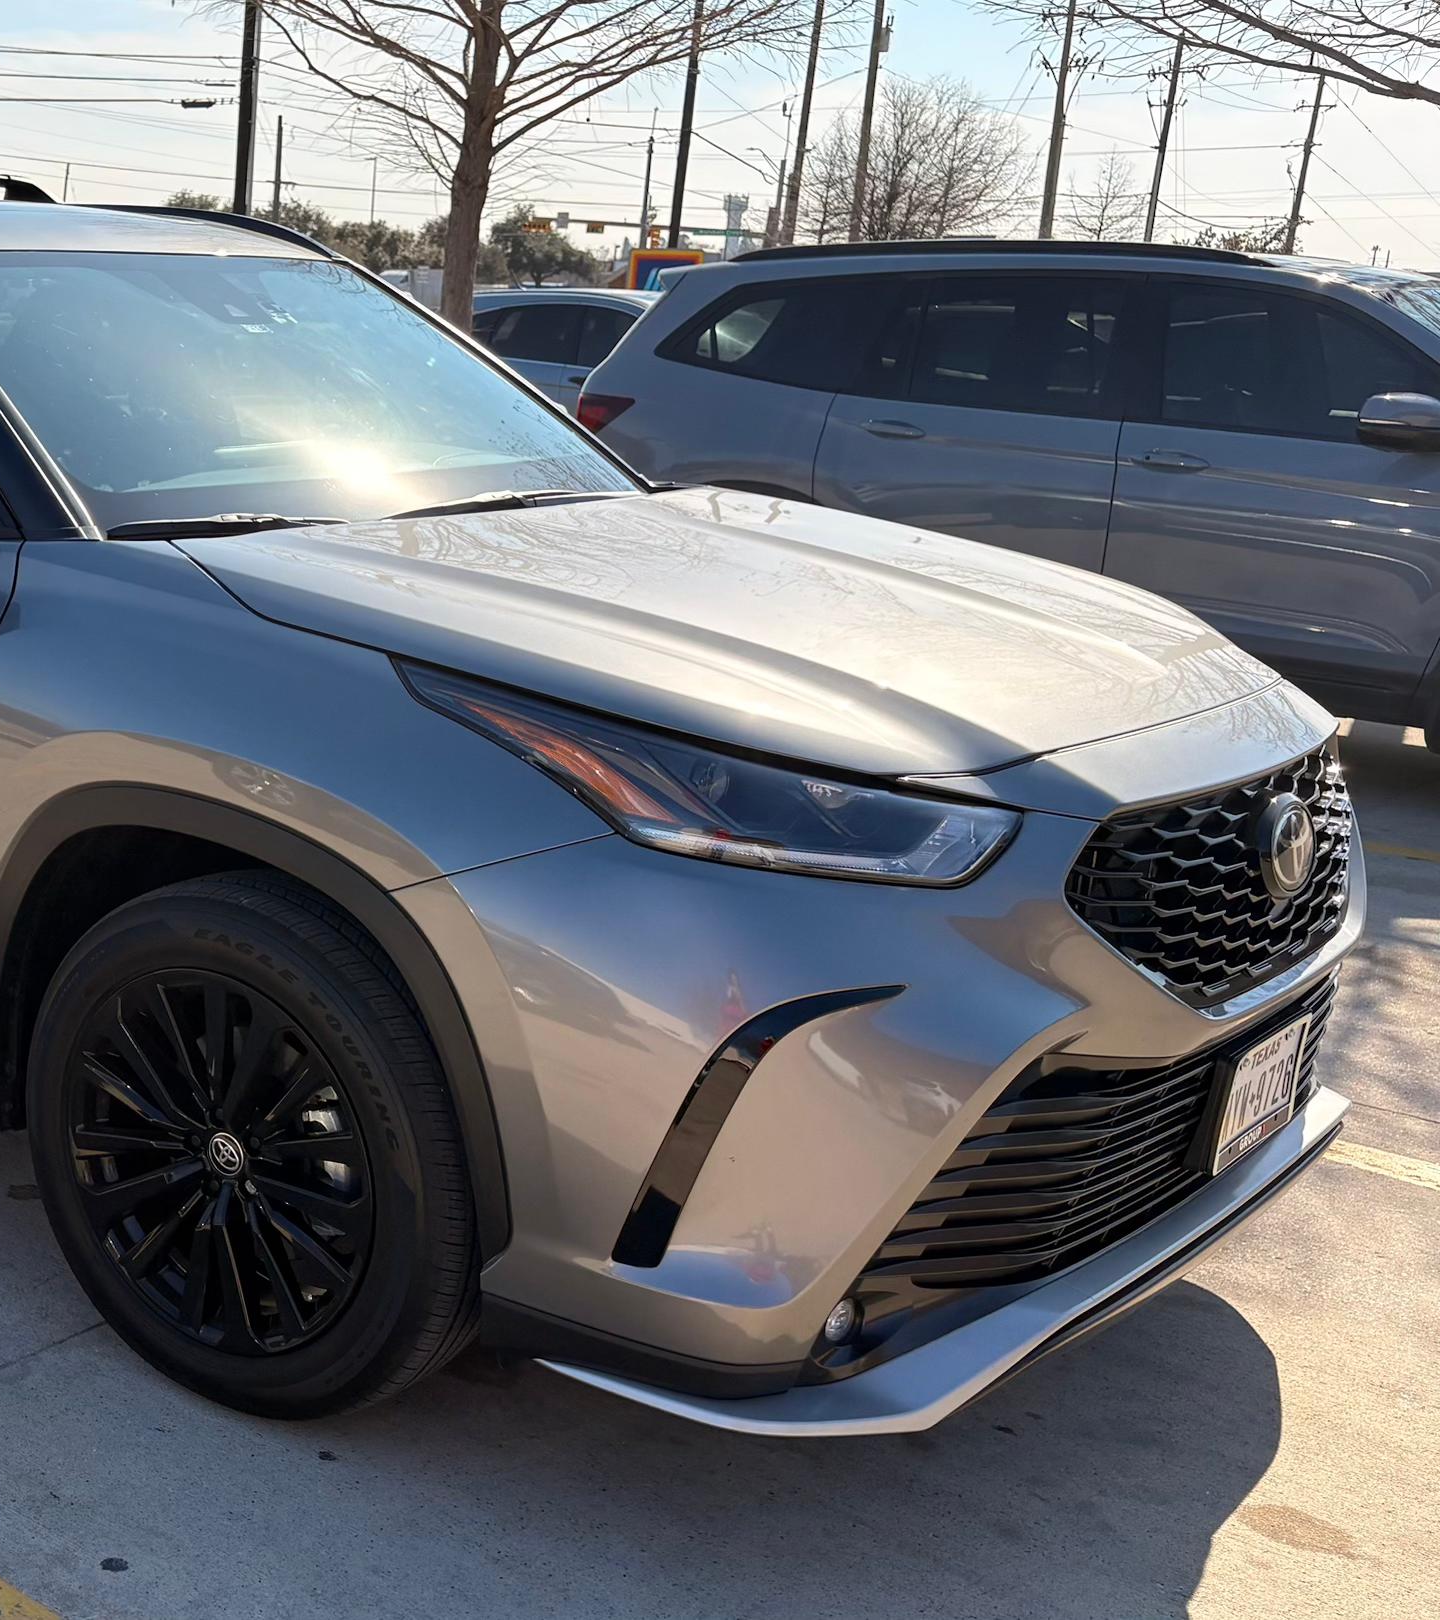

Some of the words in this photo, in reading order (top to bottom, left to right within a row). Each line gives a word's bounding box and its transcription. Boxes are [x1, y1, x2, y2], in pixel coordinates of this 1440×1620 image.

[193, 927, 300, 984] EAGLE
[309, 991, 400, 1150] TOURING
[1250, 1035, 1284, 1070] TEXAS
[1239, 1125, 1262, 1151] GROUP
